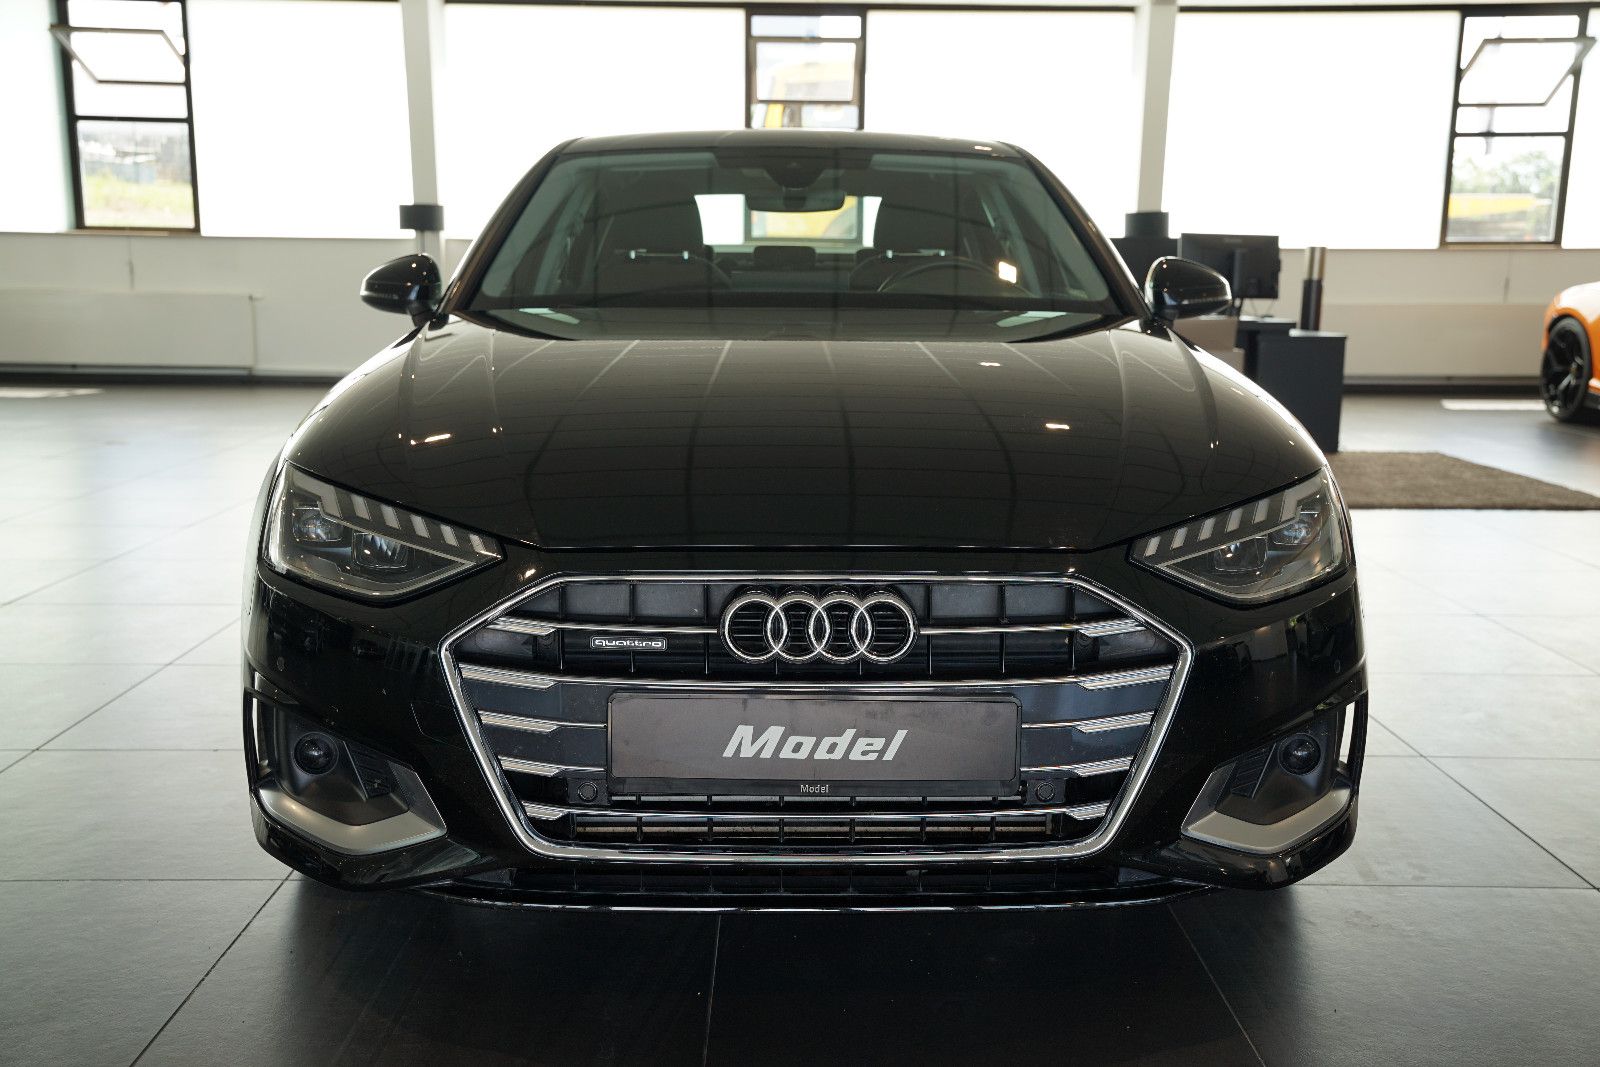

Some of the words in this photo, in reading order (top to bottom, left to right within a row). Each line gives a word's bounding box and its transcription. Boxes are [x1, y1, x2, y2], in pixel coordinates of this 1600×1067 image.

[594, 639, 662, 647] quattro
[722, 724, 909, 761] Model
[800, 784, 829, 793] Model
